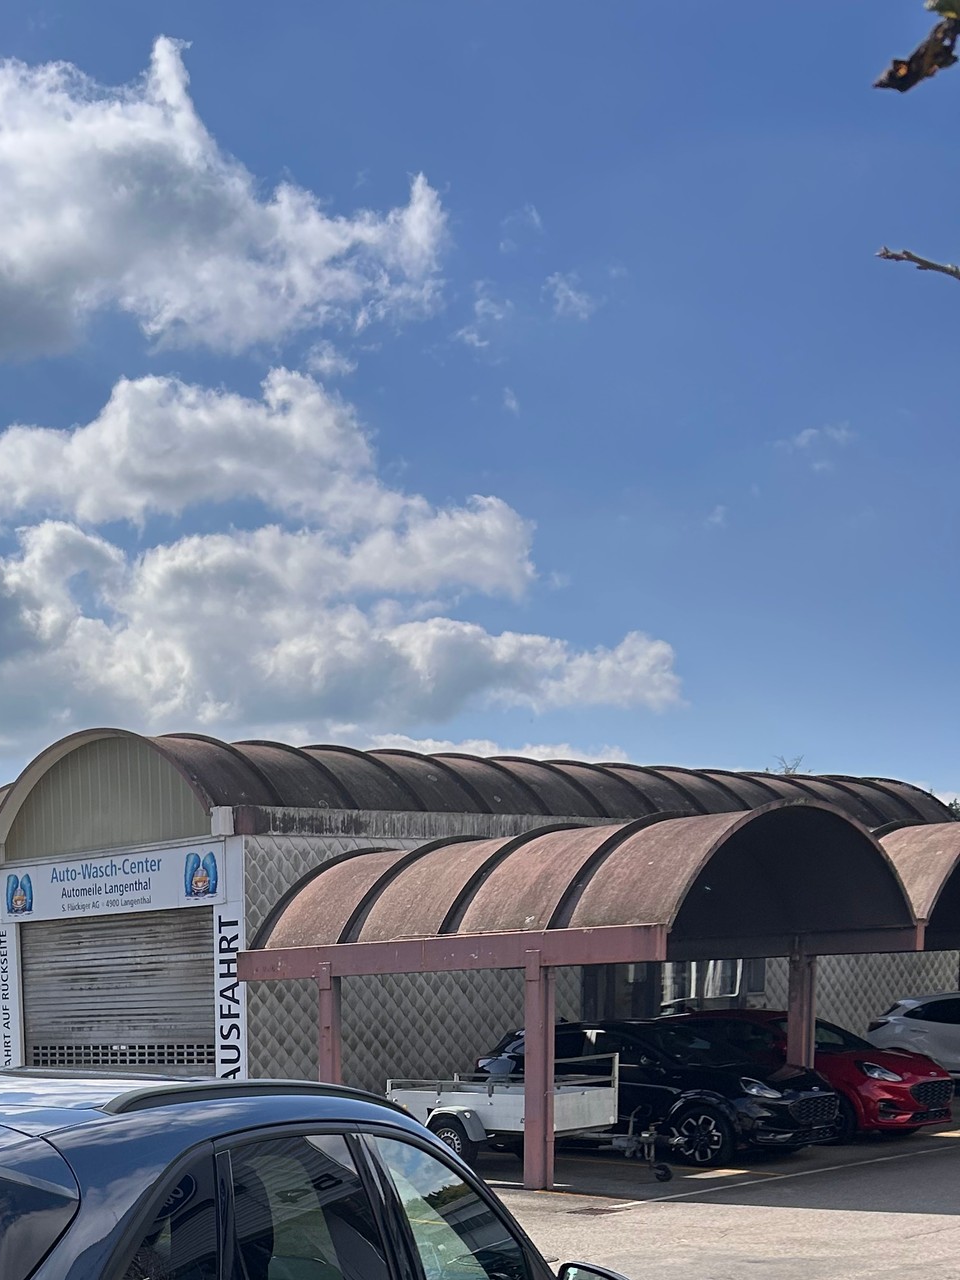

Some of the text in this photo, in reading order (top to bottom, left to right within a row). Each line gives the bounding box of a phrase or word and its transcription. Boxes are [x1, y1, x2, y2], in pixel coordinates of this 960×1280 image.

[50, 857, 162, 883] Auto-Wasch-Center
[61, 877, 151, 899] Automeile Langenthal
[91, 900, 100, 910] AG
[120, 895, 152, 907] Langenthal
[0, 929, 10, 1001] RÜCKSEITE
[2, 1004, 11, 1030] AUF
